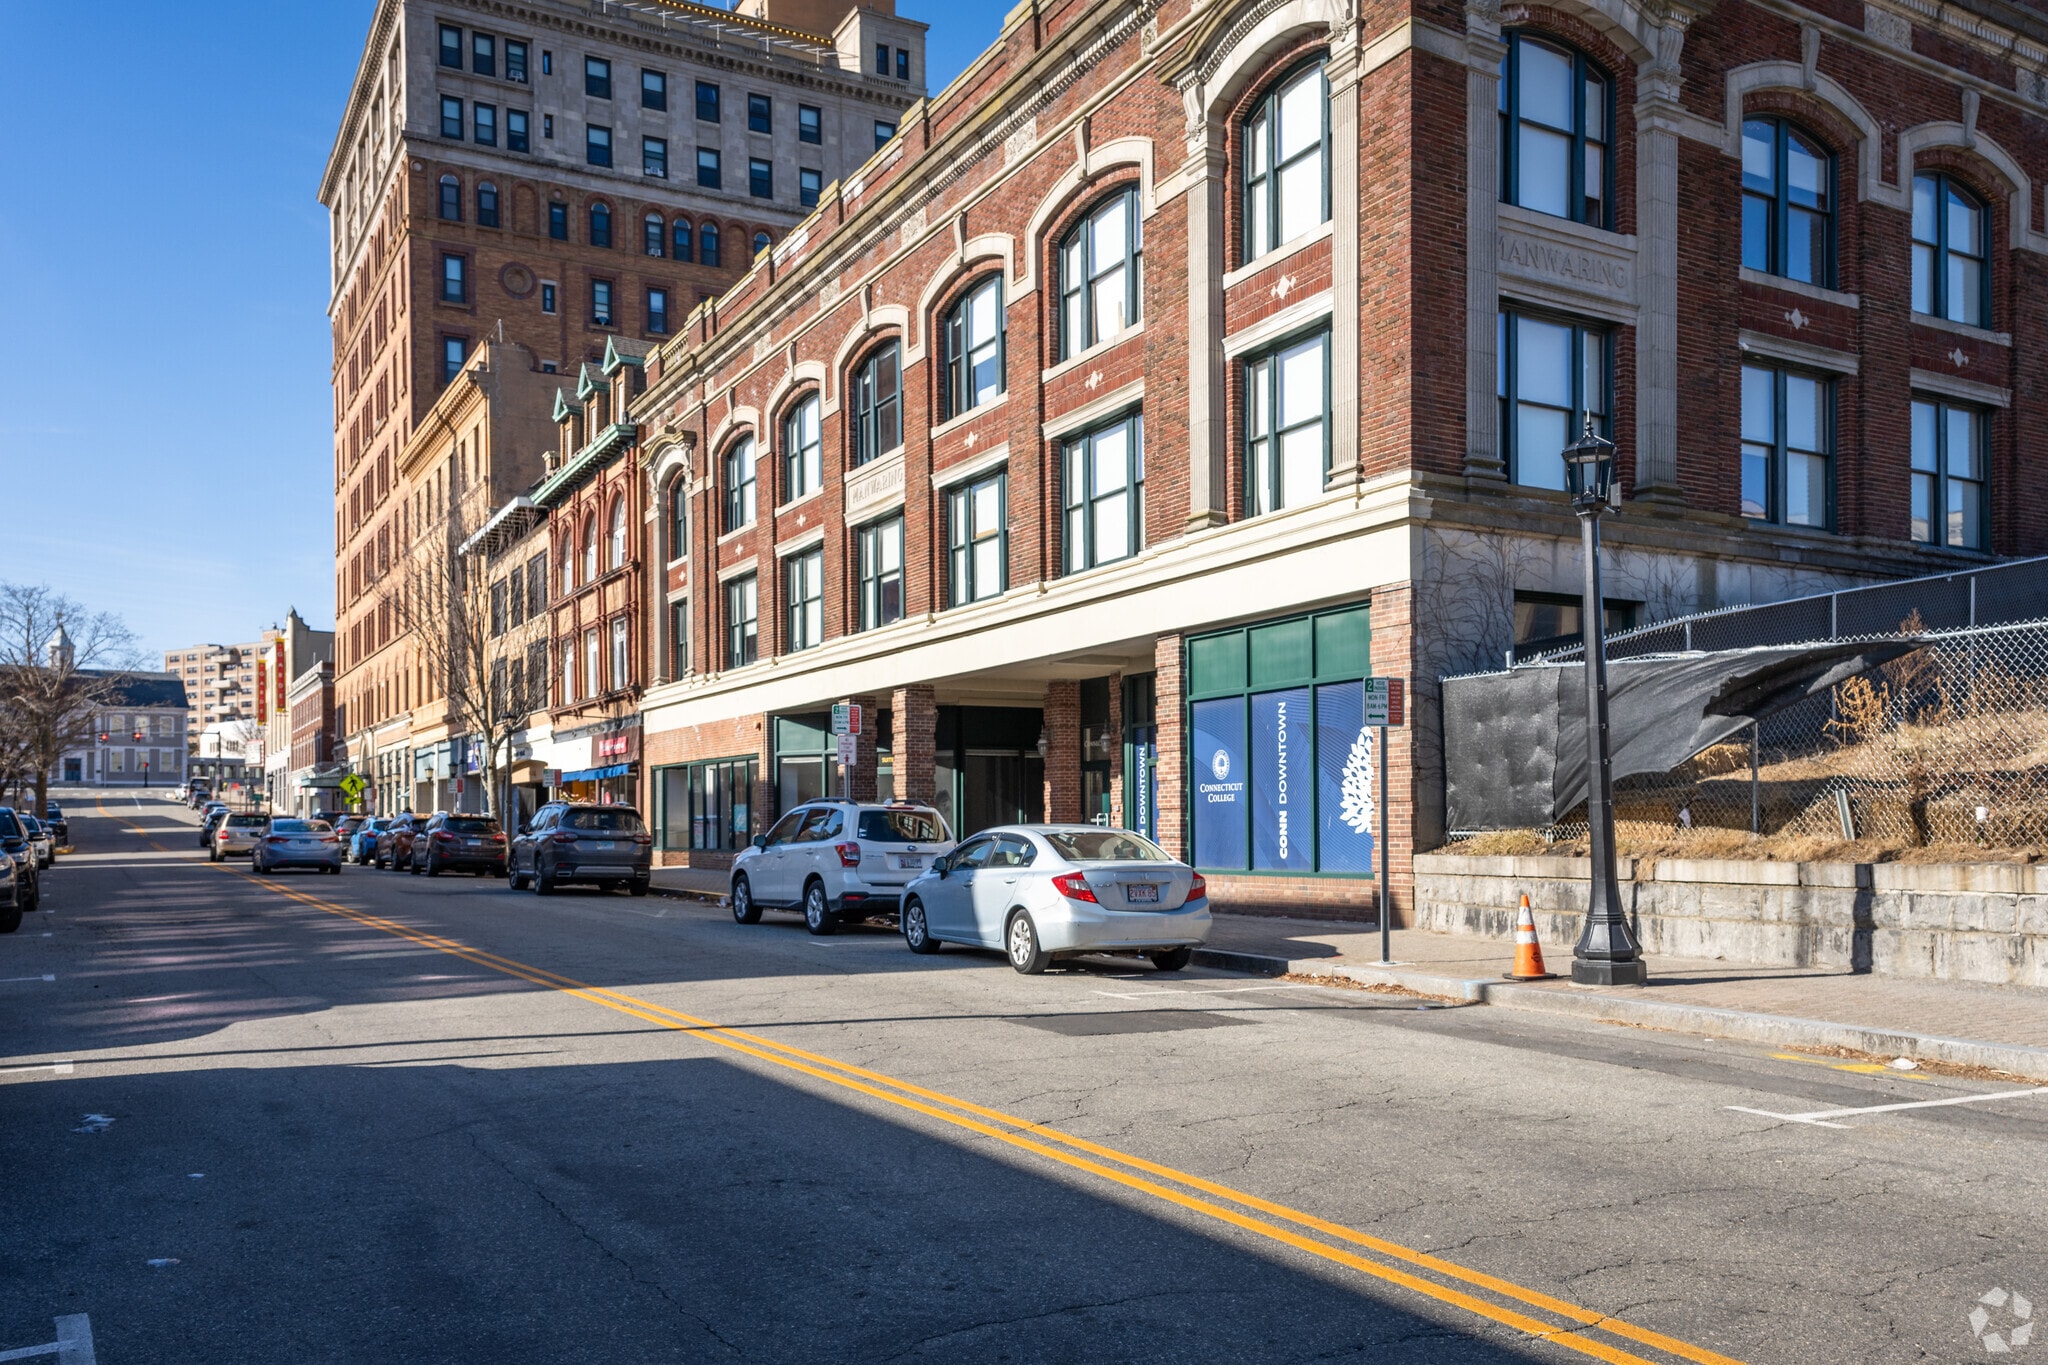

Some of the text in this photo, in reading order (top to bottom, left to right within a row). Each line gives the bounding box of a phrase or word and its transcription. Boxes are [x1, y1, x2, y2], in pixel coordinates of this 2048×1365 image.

[853, 467, 903, 504] MANWARING
[1367, 680, 1372, 691] 2
[1278, 702, 1288, 860] CONN DOWNTOWN
[1200, 782, 1243, 793] CONNECTICUT
[1208, 793, 1235, 803] COLLEGE
